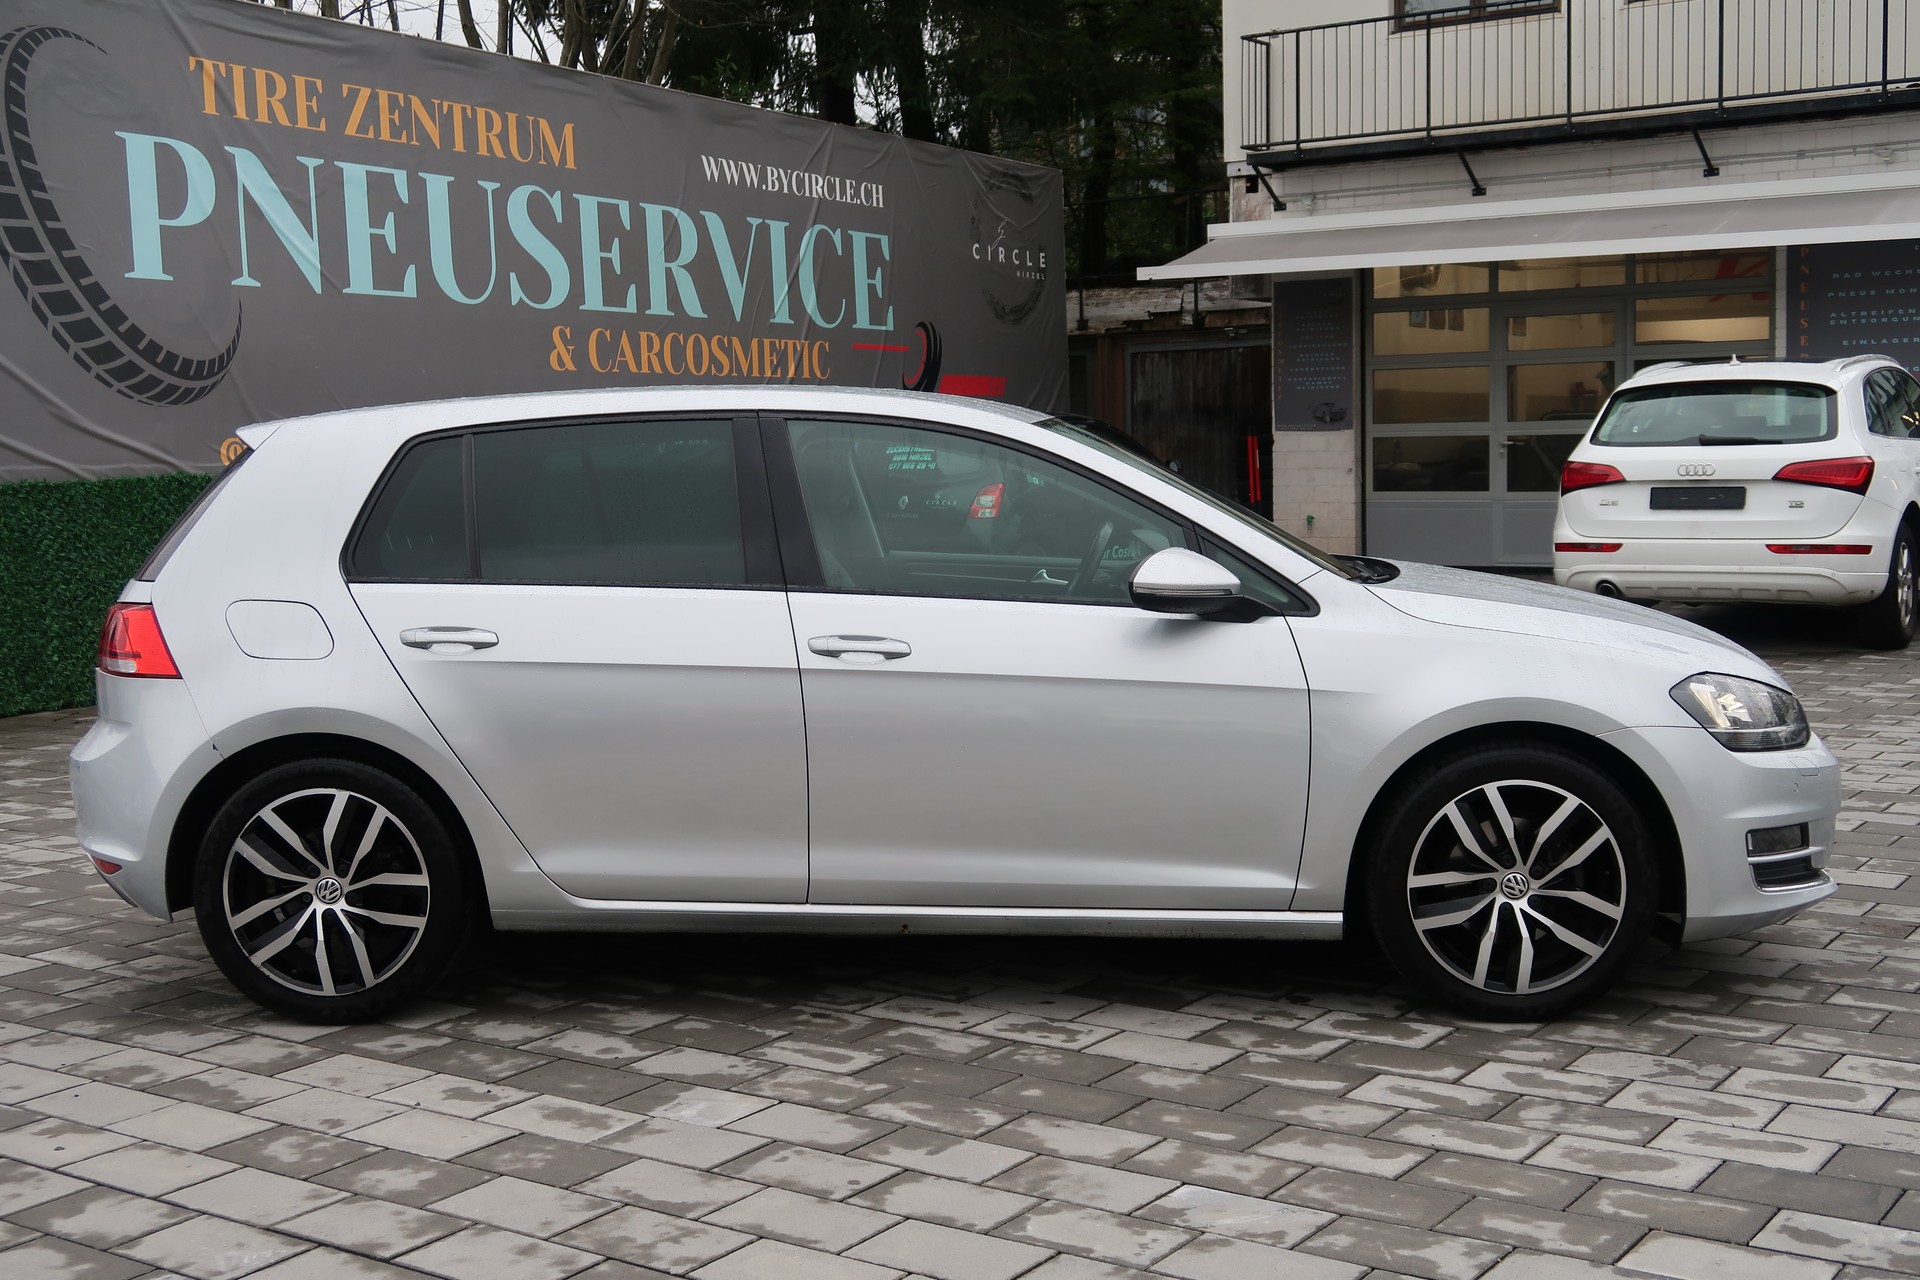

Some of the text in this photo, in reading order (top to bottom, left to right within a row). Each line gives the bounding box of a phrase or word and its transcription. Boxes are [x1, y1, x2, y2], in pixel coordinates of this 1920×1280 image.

[189, 56, 577, 170] TIRE ZENTRUM
[700, 154, 884, 208] WWW.BYCIRCLE.CH
[115, 131, 894, 331] PNEUSERVICE
[972, 243, 1046, 268] CIRCLE
[1827, 290, 1877, 298] PNEUS
[1830, 308, 1917, 318] ALTREIFEN
[550, 325, 831, 380] & CARCOSMETIC
